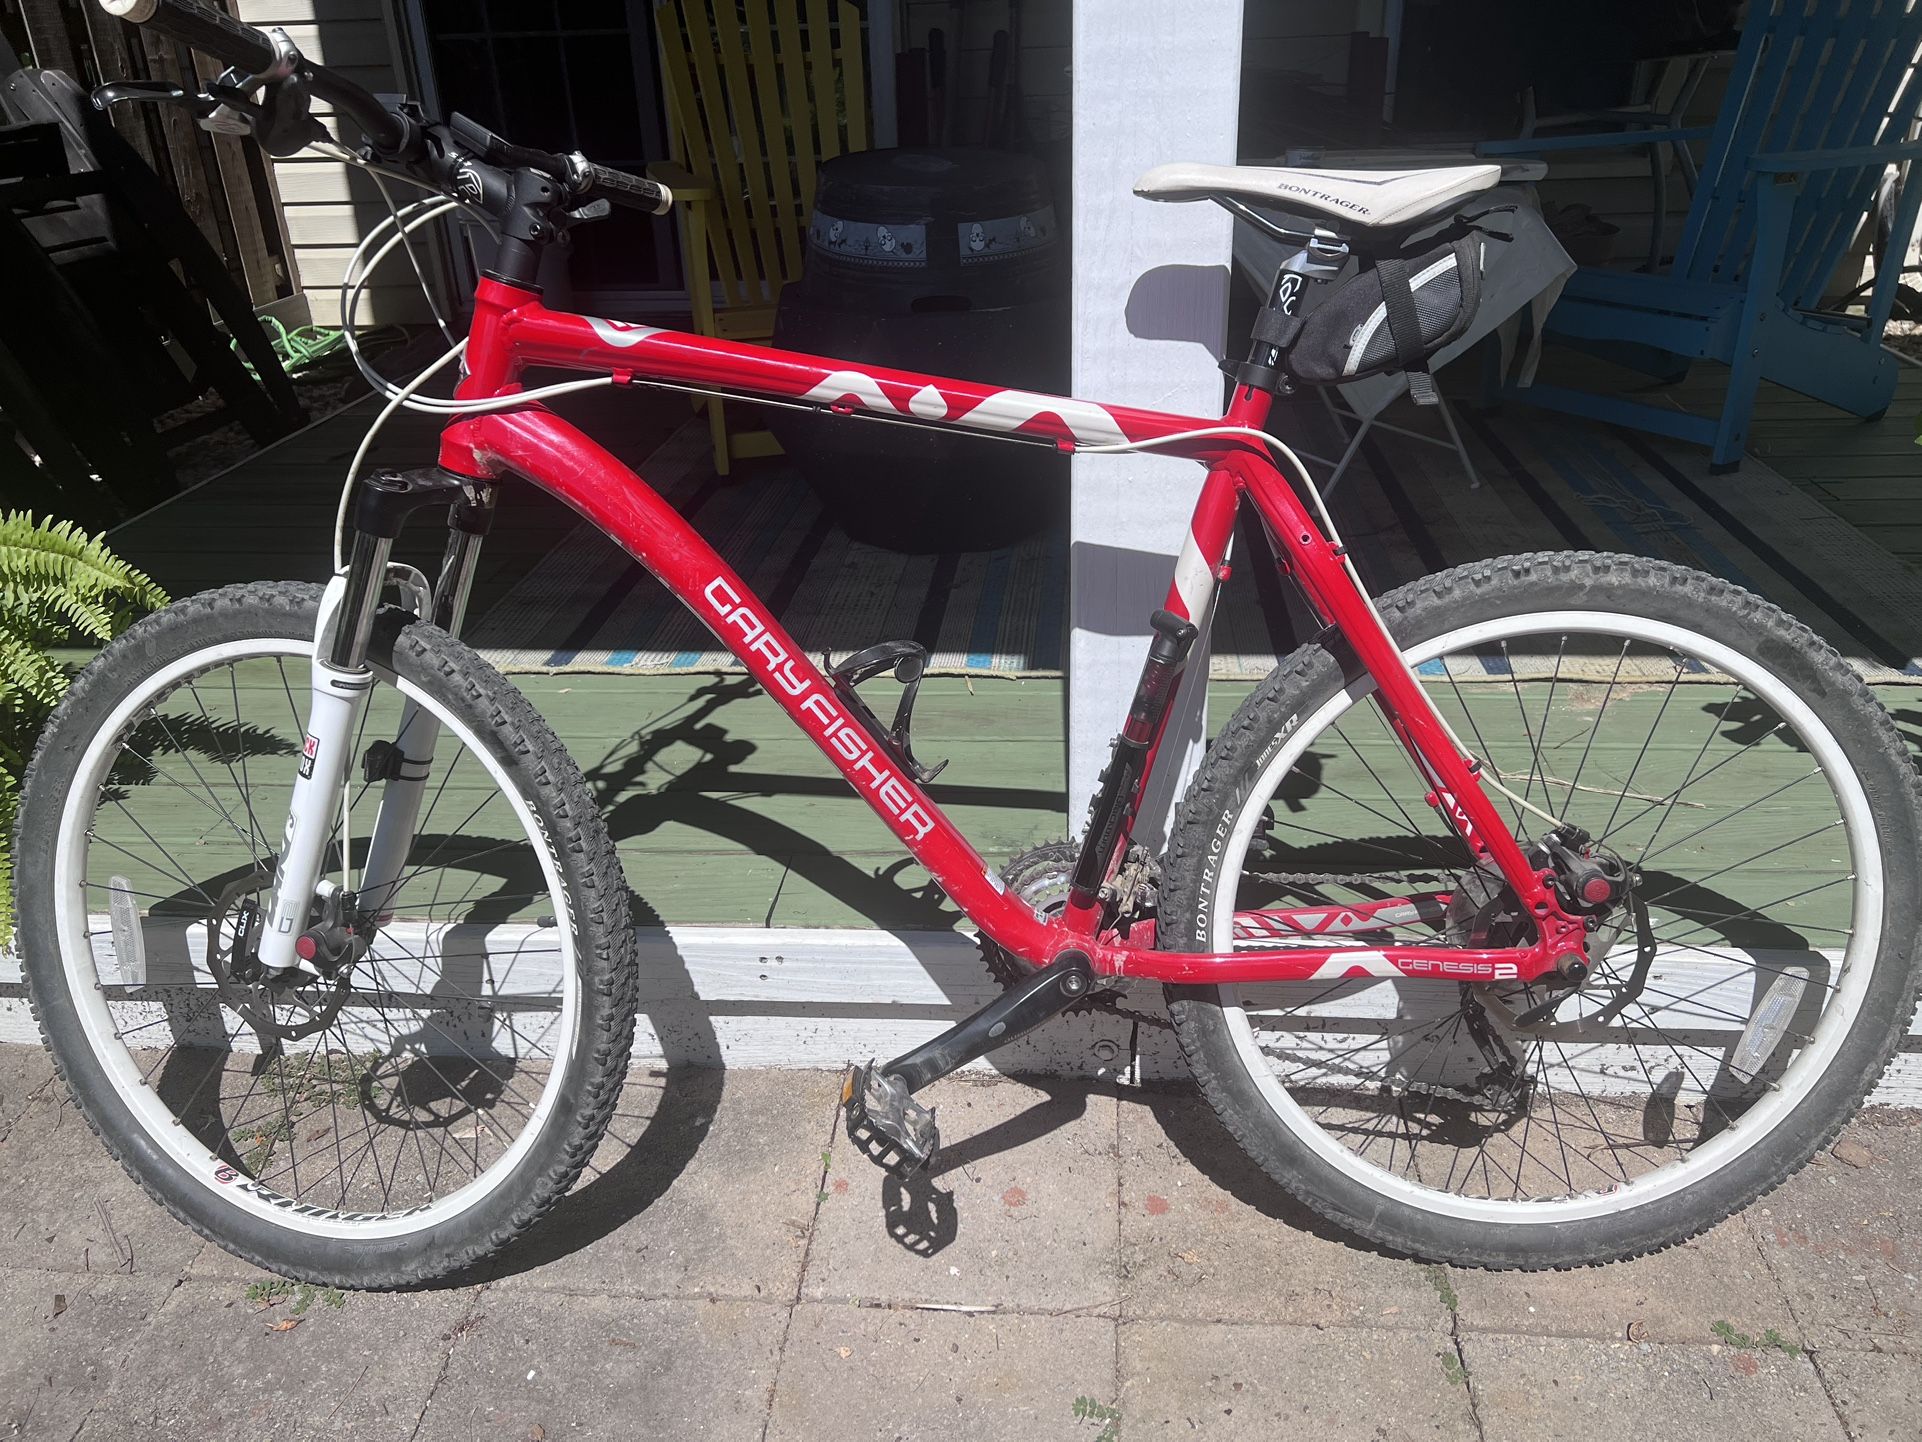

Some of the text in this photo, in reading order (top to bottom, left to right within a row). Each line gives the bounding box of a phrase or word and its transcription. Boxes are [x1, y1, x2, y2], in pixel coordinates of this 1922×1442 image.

[1277, 183, 1369, 216] BONTRAGER
[704, 576, 935, 841] GARY FISHER
[525, 800, 578, 936] BONTRAGER
[1195, 809, 1233, 942] BONTRAGER
